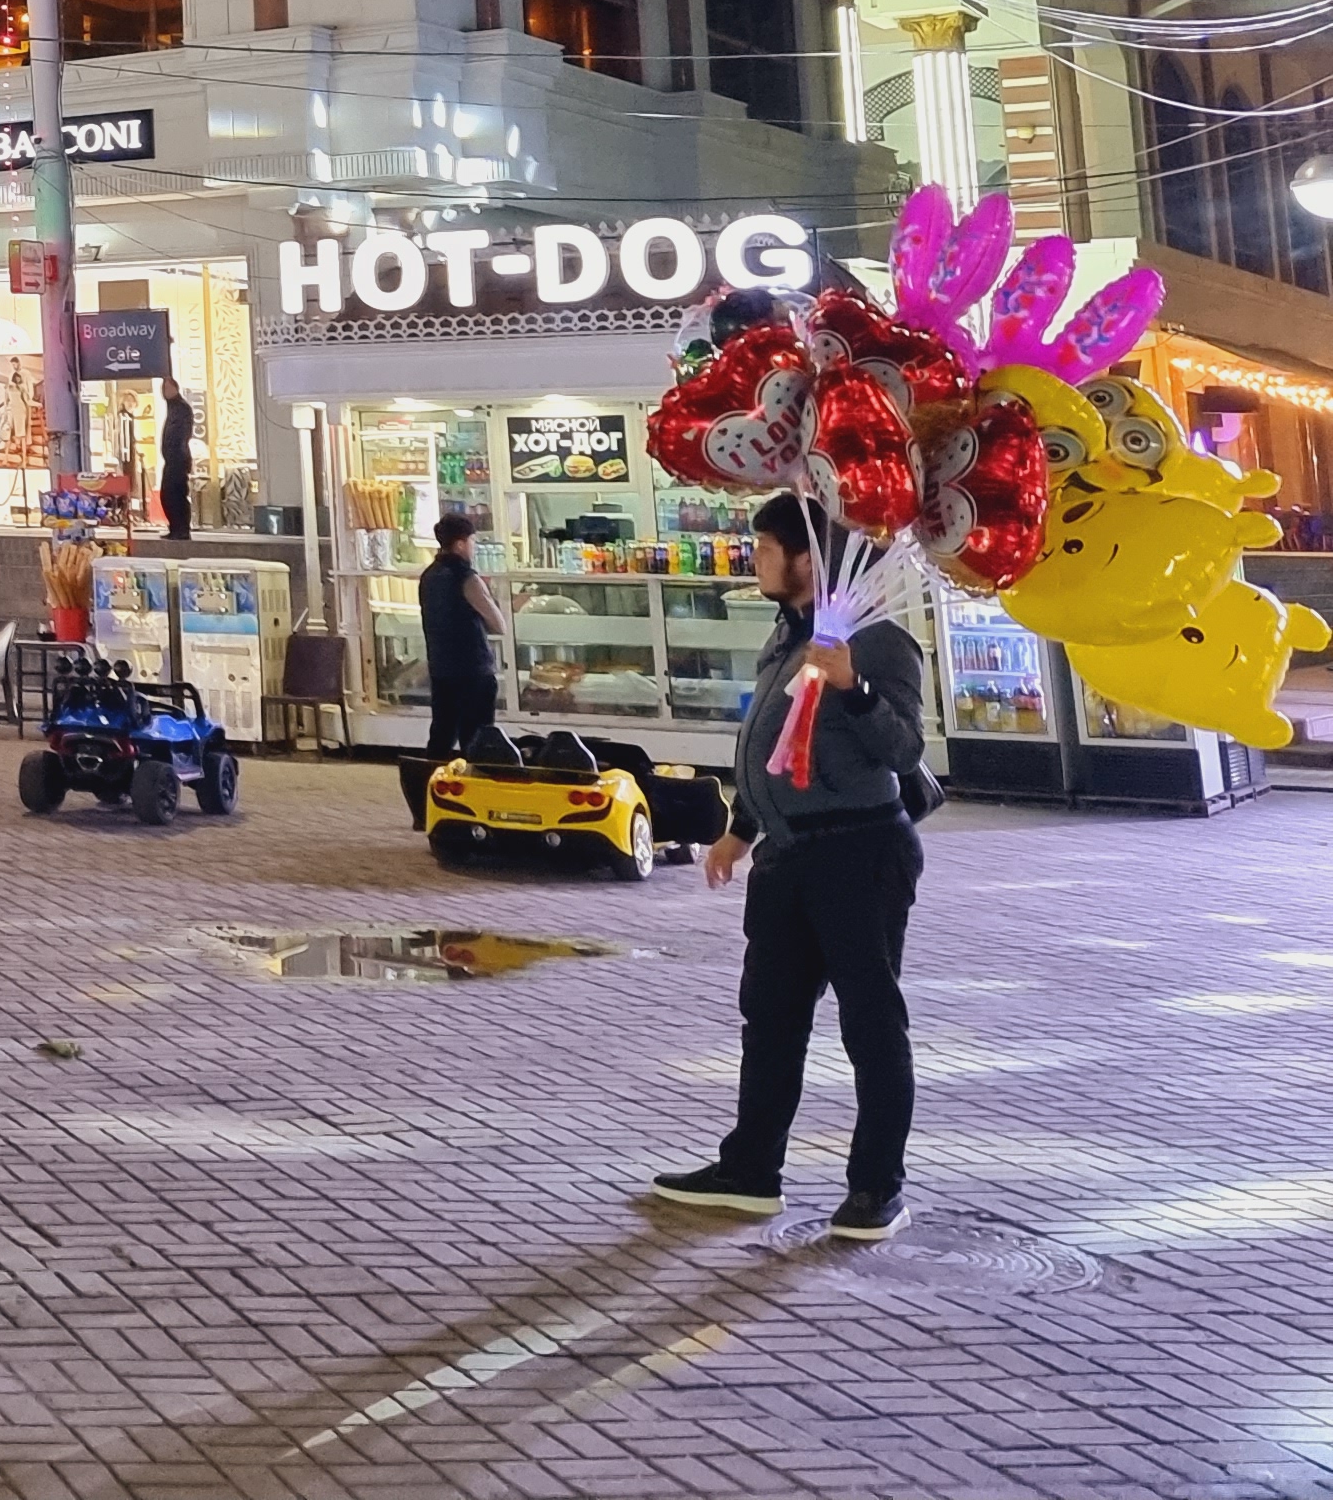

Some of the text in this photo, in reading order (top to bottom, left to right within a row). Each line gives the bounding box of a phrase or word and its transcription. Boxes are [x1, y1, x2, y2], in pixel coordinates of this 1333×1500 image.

[278, 214, 816, 315] HOT-DOG
[83, 322, 156, 341] Broadway
[106, 346, 141, 363] Cafe
[531, 417, 601, 433] МЯСНОЙ
[511, 431, 623, 455] ХОТ-ДОГ
[762, 434, 802, 474] YO
